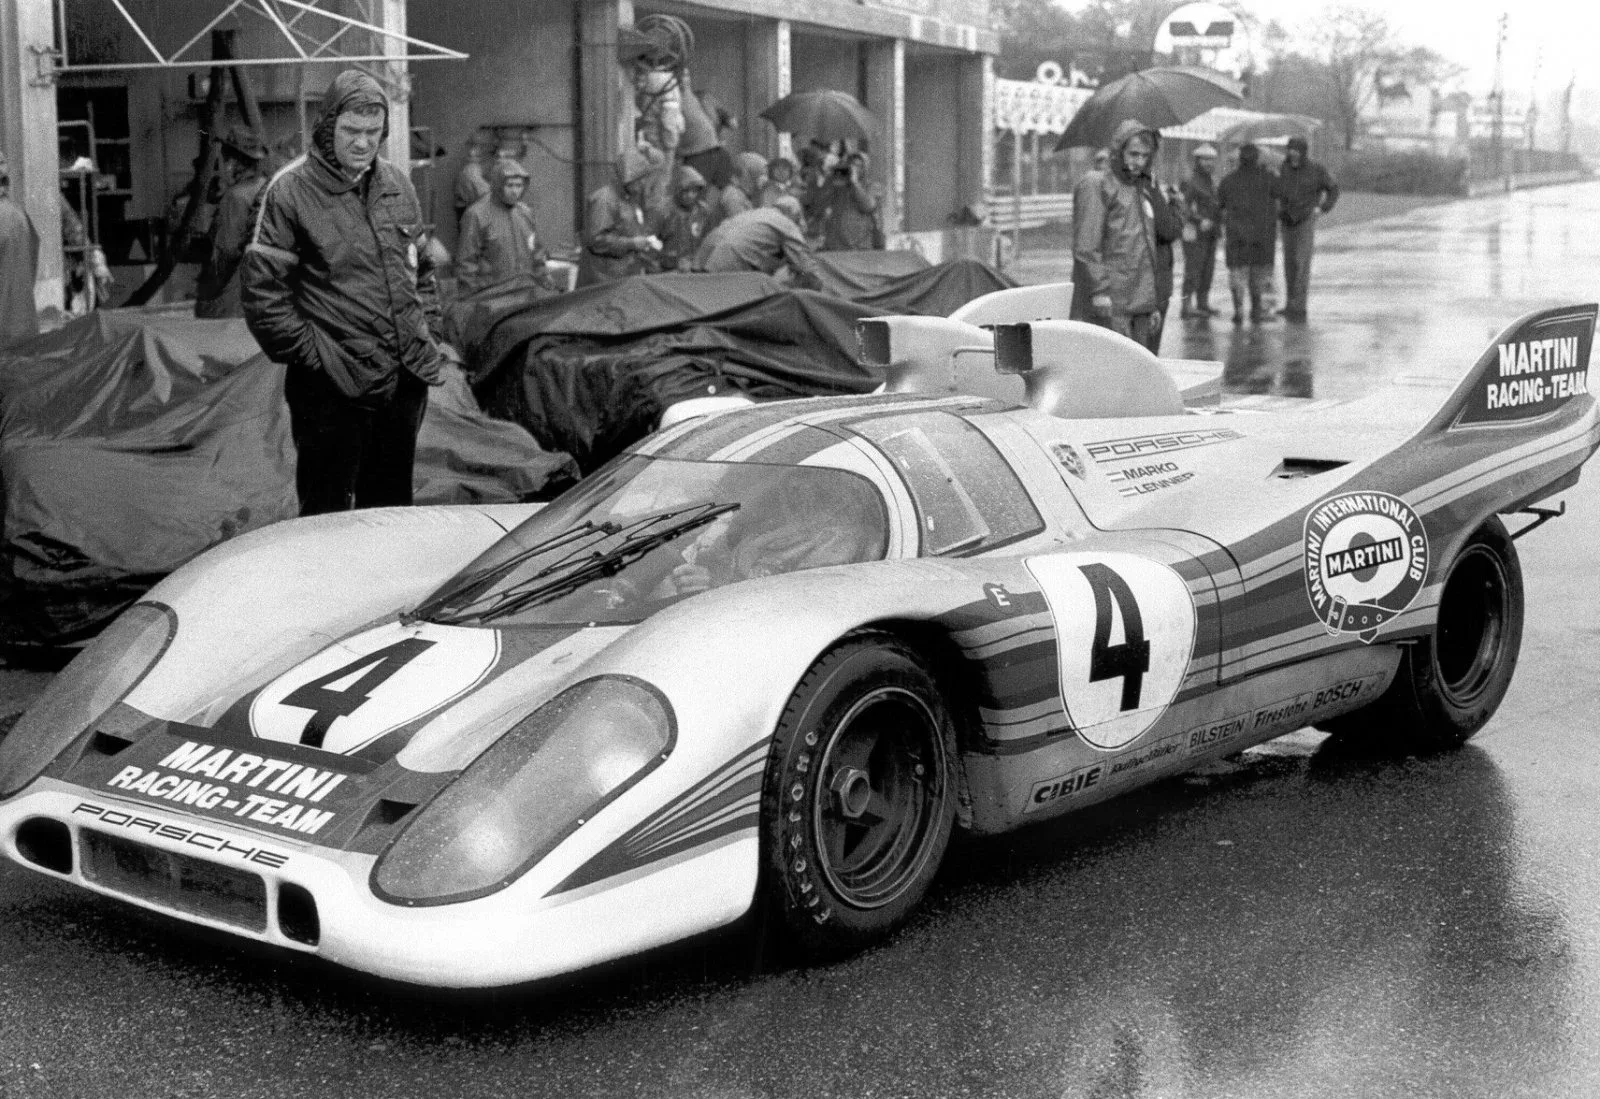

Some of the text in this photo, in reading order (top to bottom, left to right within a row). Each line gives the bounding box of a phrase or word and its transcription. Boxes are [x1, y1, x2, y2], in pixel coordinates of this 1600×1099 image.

[1498, 336, 1578, 377] MARTINI
[1487, 370, 1588, 410] RACING-TEAM
[1086, 430, 1238, 458] PORSCHE
[1122, 461, 1179, 481] MARKO
[1307, 494, 1426, 610] MARTINI INTERNATIONAL CLUB
[1328, 540, 1401, 576] MARTINI
[991, 588, 1010, 606] E
[1077, 562, 1150, 712] 4
[278, 637, 438, 748] 4
[1312, 680, 1362, 709] BOSCH
[1190, 717, 1246, 748] BILSTEIN
[158, 741, 347, 803] MARTINI
[107, 764, 336, 835] RACING-TEAM
[71, 802, 290, 869] PORSCHE
